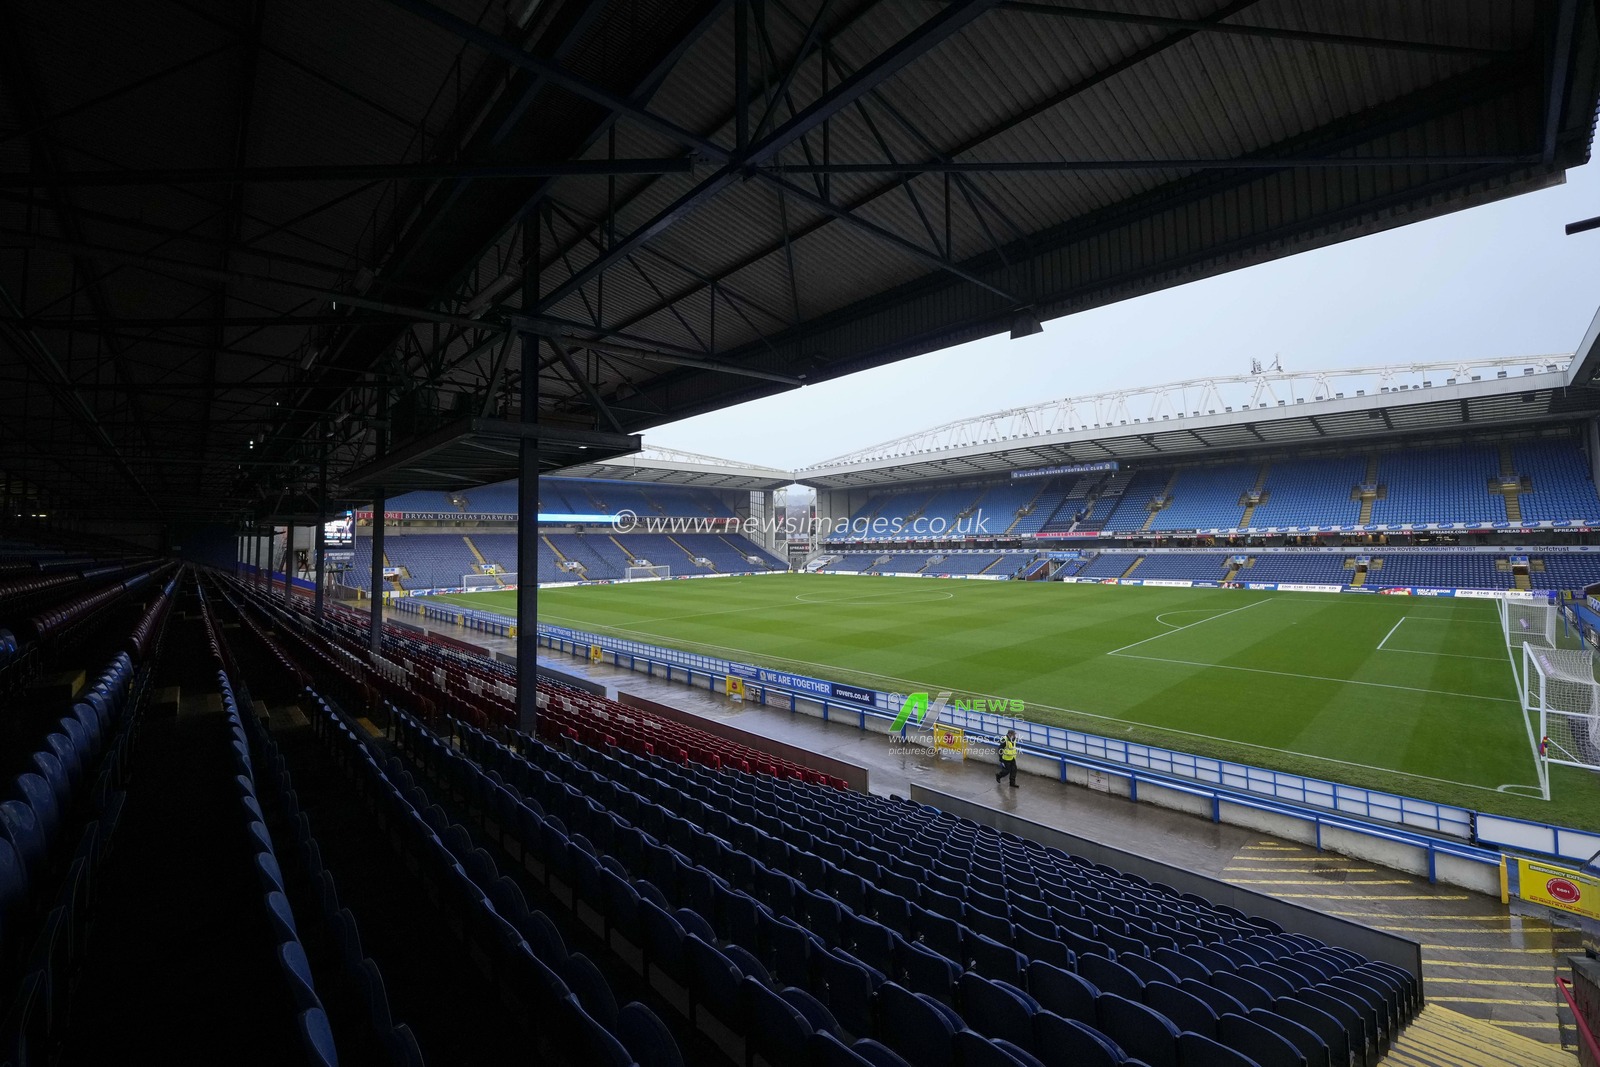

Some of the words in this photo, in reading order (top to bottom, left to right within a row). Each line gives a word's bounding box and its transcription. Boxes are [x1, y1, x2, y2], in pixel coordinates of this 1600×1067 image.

[766, 672, 776, 682] WE
[778, 675, 791, 685] ARE
[793, 678, 830, 694] TOGETHER
[836, 690, 870, 702] rovers.co.uk
[1530, 865, 1565, 877] EMERGENCY
